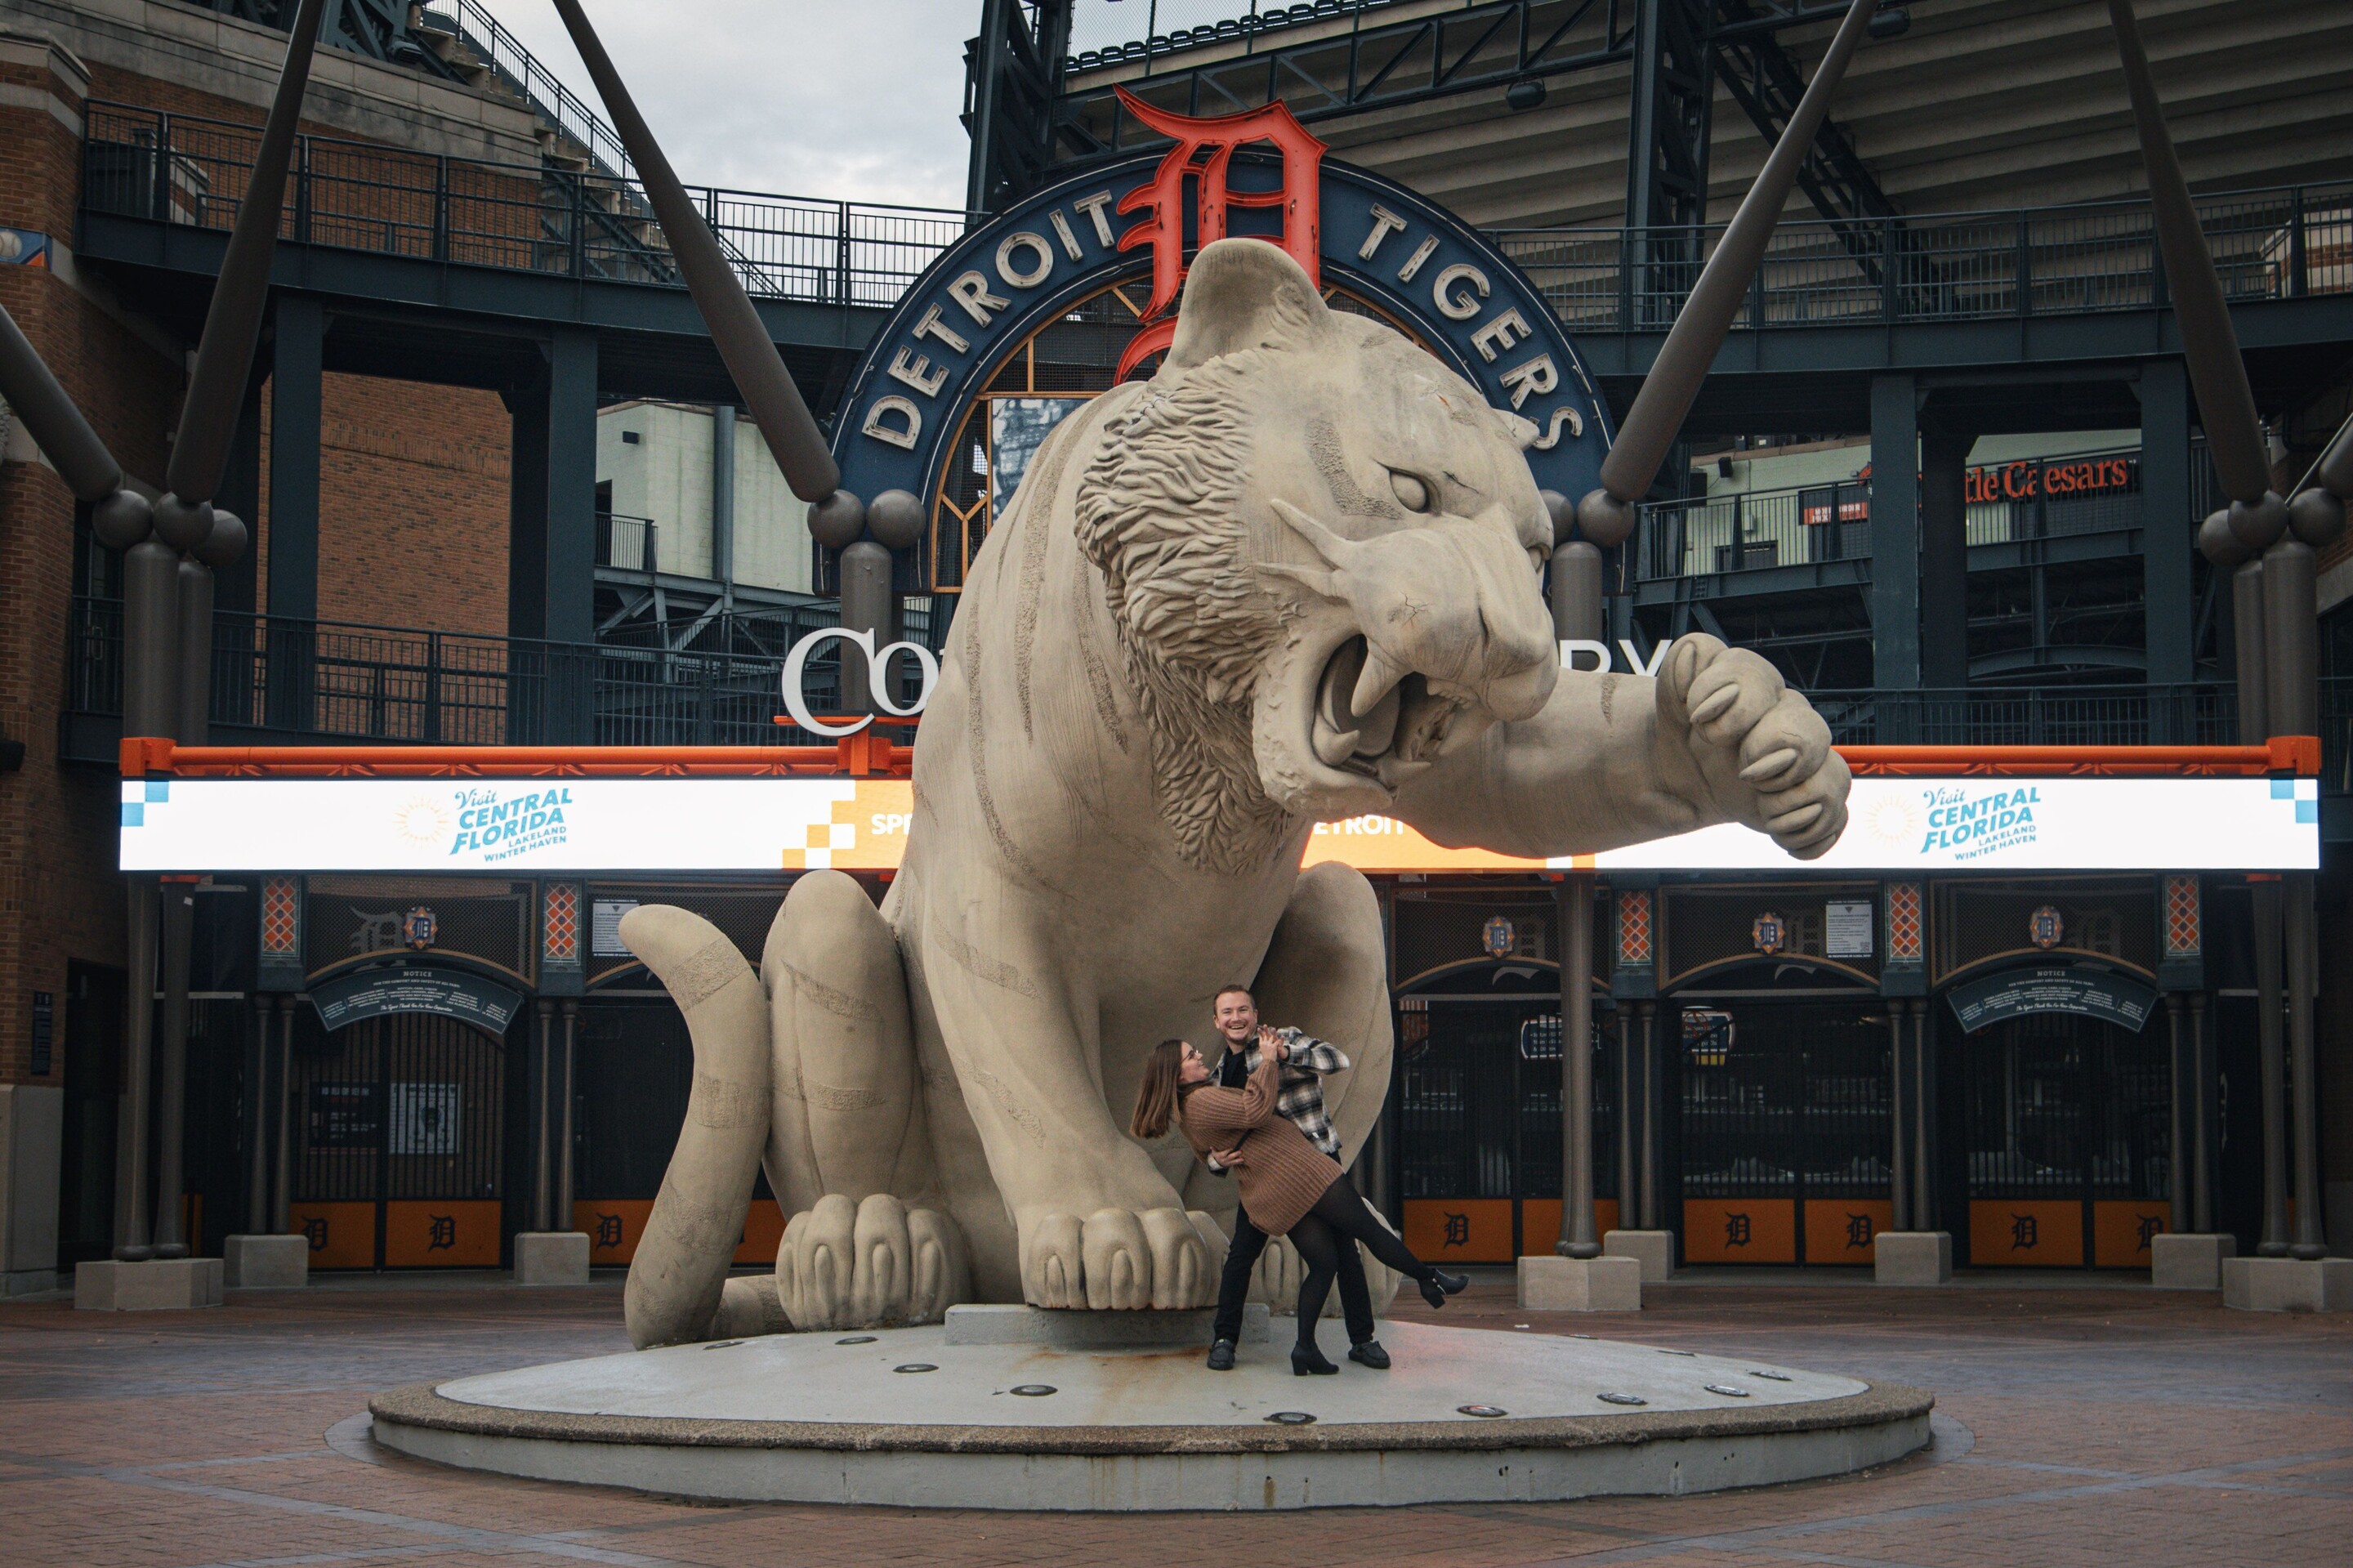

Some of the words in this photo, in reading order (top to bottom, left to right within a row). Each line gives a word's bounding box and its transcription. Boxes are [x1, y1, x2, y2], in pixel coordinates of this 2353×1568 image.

[861, 190, 1115, 450] DETROIT
[1359, 203, 1583, 451] TIGERS
[2004, 459, 2128, 498] Caesars
[455, 788, 498, 810] Visit
[458, 788, 574, 830] CENTRAL
[1923, 786, 1967, 808] Visit
[1928, 787, 2041, 829] CENTRAL
[449, 807, 565, 856] FLORIDA
[508, 826, 567, 848] LAKELAND
[1920, 806, 2034, 855] FLORIDA
[1954, 845, 1996, 860] WINTER
[1998, 833, 2036, 850] HAVEN
[1978, 824, 2036, 847] LAKELAND
[484, 846, 527, 862] WINTER
[529, 835, 567, 851] HAVEN
